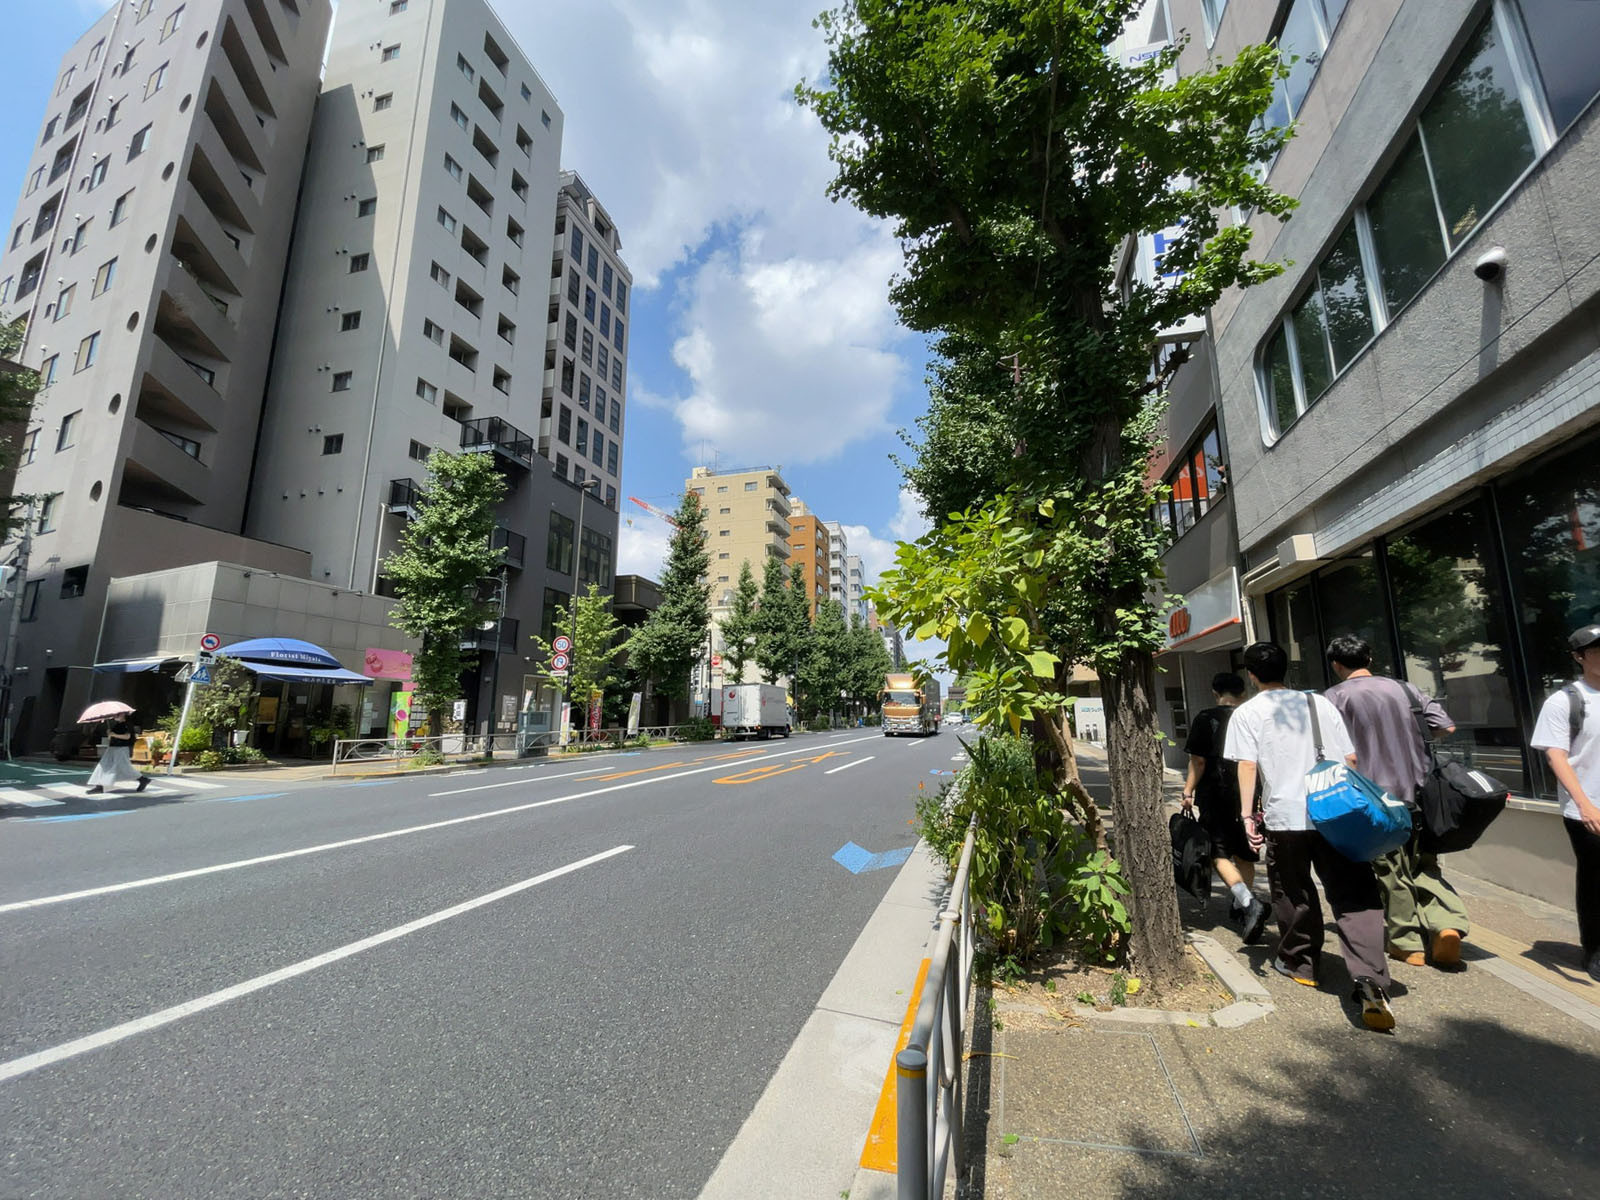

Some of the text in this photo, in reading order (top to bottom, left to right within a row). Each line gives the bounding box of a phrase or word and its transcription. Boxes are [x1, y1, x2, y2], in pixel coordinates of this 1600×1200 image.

[556, 640, 567, 649] 50
[270, 651, 298, 660] Florist
[1305, 763, 1348, 796] NIKE
